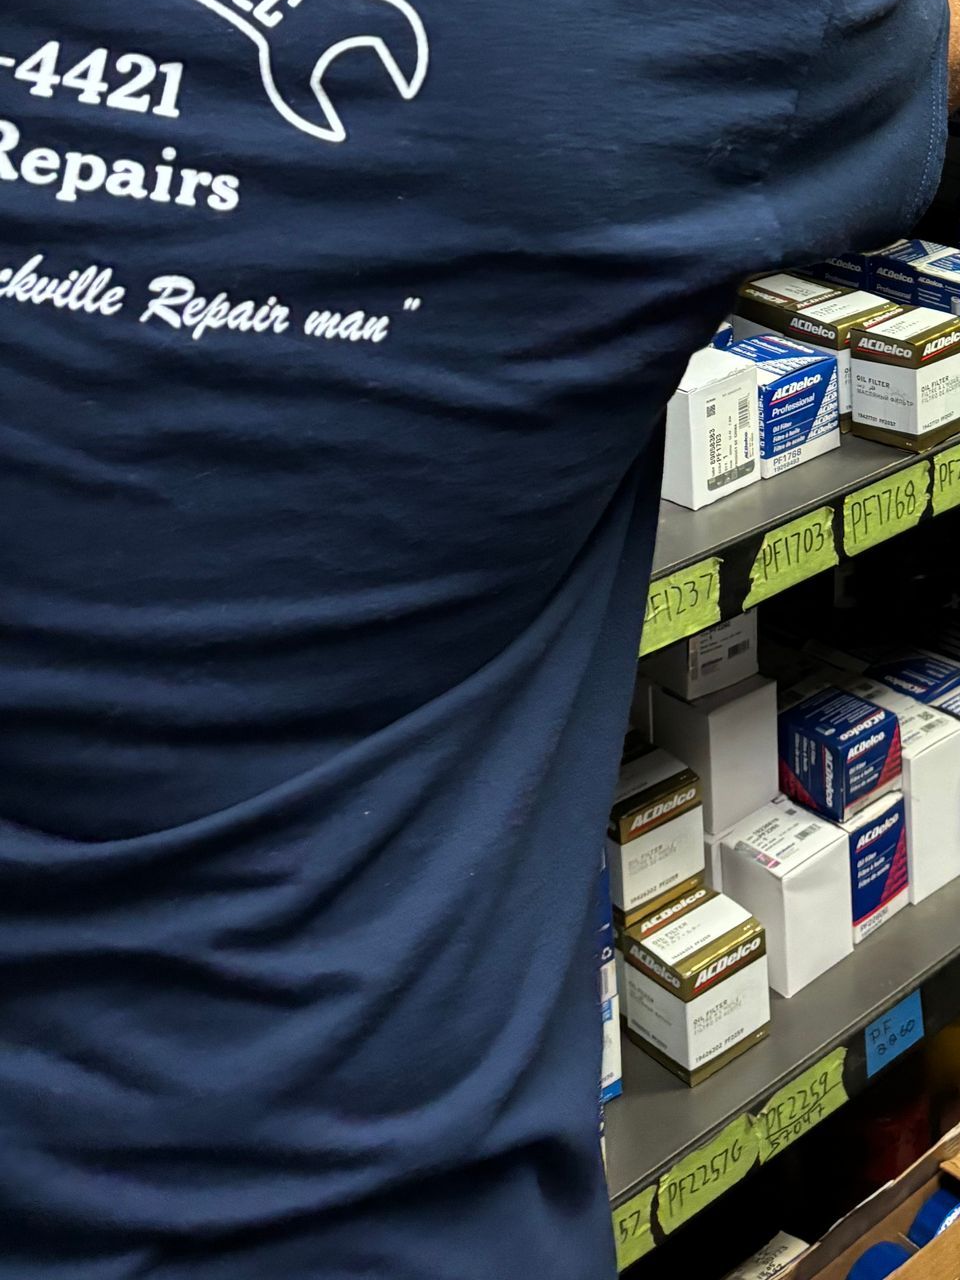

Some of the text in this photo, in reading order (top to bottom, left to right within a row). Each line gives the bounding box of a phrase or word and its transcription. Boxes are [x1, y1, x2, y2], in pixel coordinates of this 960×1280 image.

[0, 121, 241, 211] Repairs
[877, 267, 913, 283] ACDelco
[139, 274, 291, 340] Repair
[791, 318, 835, 339] ACDelco
[858, 337, 912, 358] ACDelco
[772, 374, 821, 401] ACDelco
[772, 393, 815, 418] Professional
[773, 448, 801, 466] PF1768
[850, 480, 917, 543] PF1768
[763, 528, 825, 580] PF1703
[847, 732, 885, 761] ACDelco
[824, 745, 834, 808] ACDelco
[630, 788, 696, 831] ACDelco
[856, 813, 899, 849] ACDelco
[641, 889, 707, 933] ACDelco
[630, 944, 681, 989] ACDelco
[694, 937, 761, 988] ACDelco
[870, 1024, 891, 1042] PF
[763, 1071, 830, 1133] PF2259
[667, 1138, 743, 1218] PF2257G
